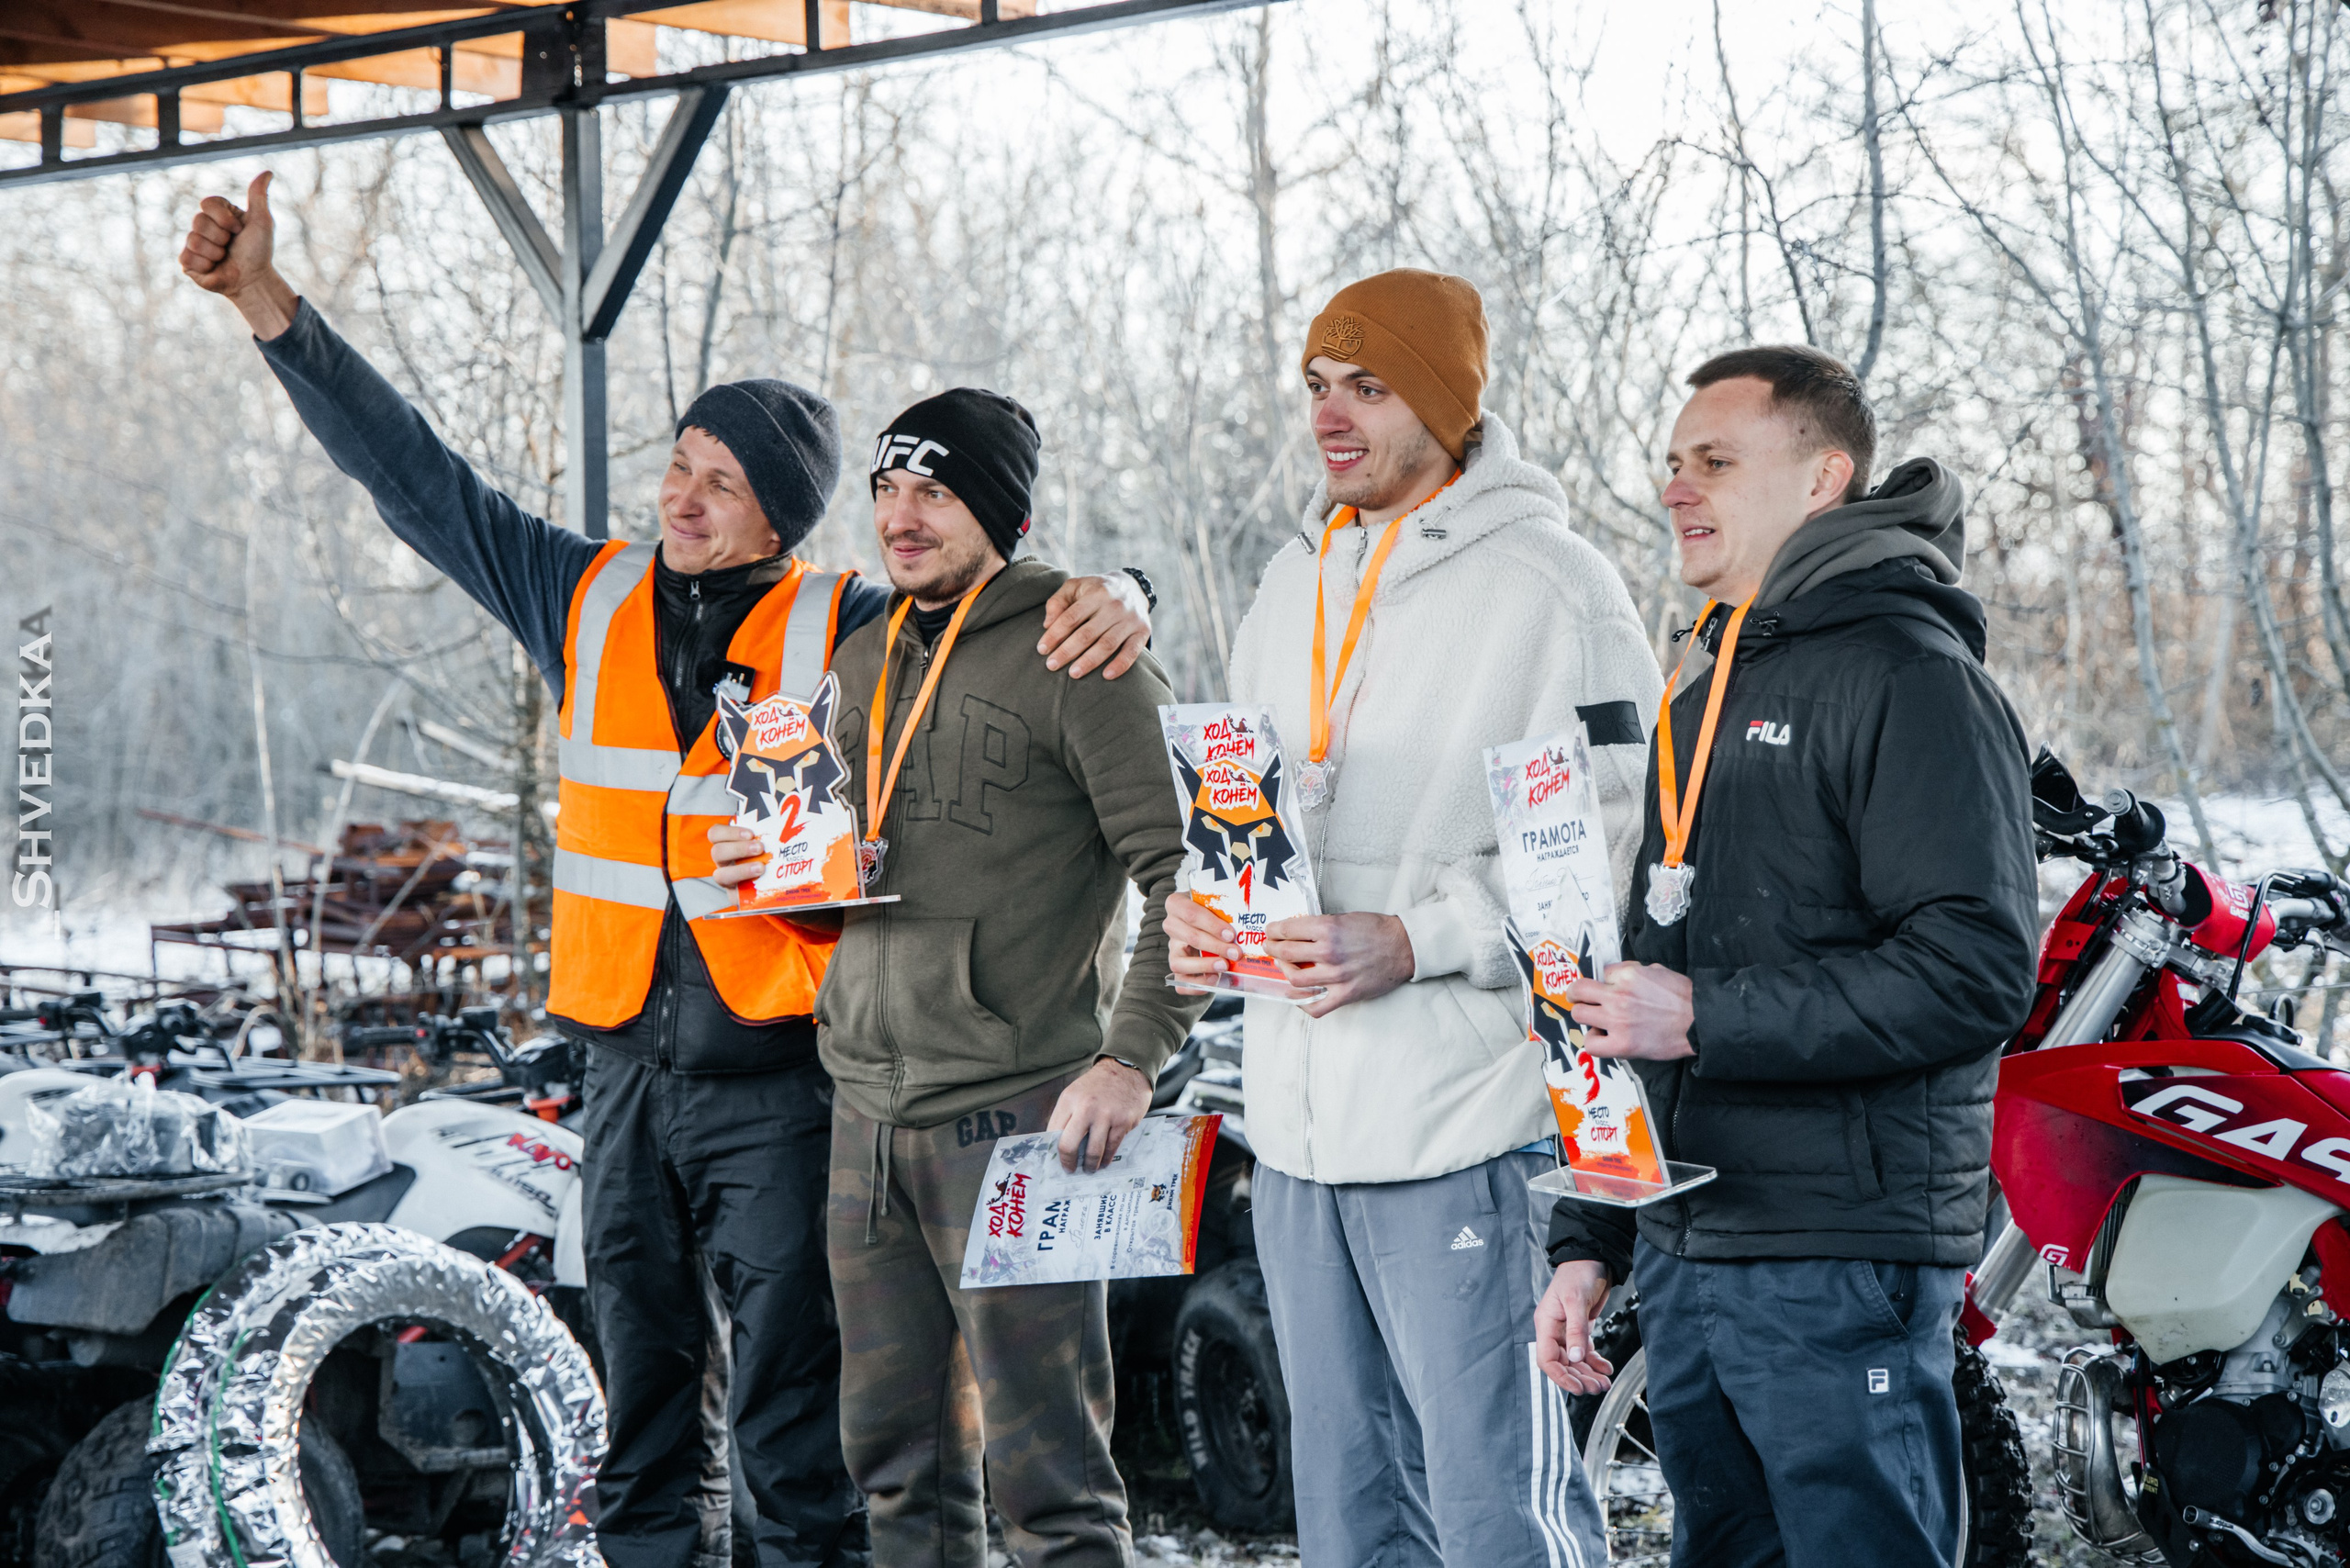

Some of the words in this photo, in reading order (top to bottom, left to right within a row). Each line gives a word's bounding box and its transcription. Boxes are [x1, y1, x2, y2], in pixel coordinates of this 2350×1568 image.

[870, 434, 949, 476] UFC
[754, 706, 778, 726] ХОД
[759, 717, 806, 745] КОНЁМ
[1203, 717, 1231, 741] ХОД
[1746, 720, 1790, 745] FILA
[1206, 734, 1255, 762] КОНЁМ
[1206, 768, 1231, 784] ХОД
[1525, 751, 1550, 781] ХОД
[1213, 782, 1259, 806] КОНЁМ
[1528, 766, 1570, 808] КОНЁМ
[778, 794, 811, 844] 2
[1522, 819, 1586, 853] ГРАМОТА
[778, 842, 808, 859] МЕСТО
[1537, 845, 1579, 862] НАГРАЖДАЕТСЯ
[776, 858, 814, 879] СПОРТ
[1238, 864, 1252, 911] 1
[1237, 913, 1266, 925] МЕСТО
[1537, 948, 1555, 967] ХОД
[1545, 964, 1578, 989] КОНЁМ
[1577, 1051, 1600, 1105] 3
[1587, 1106, 1609, 1119] МЕСТО
[956, 1109, 1017, 1148] GAP
[1591, 1126, 1617, 1142] СПОРТ
[1006, 1172, 1032, 1238] КОНЁМ
[989, 1202, 1009, 1238] ХОД
[1450, 1238, 1484, 1250] adidas
